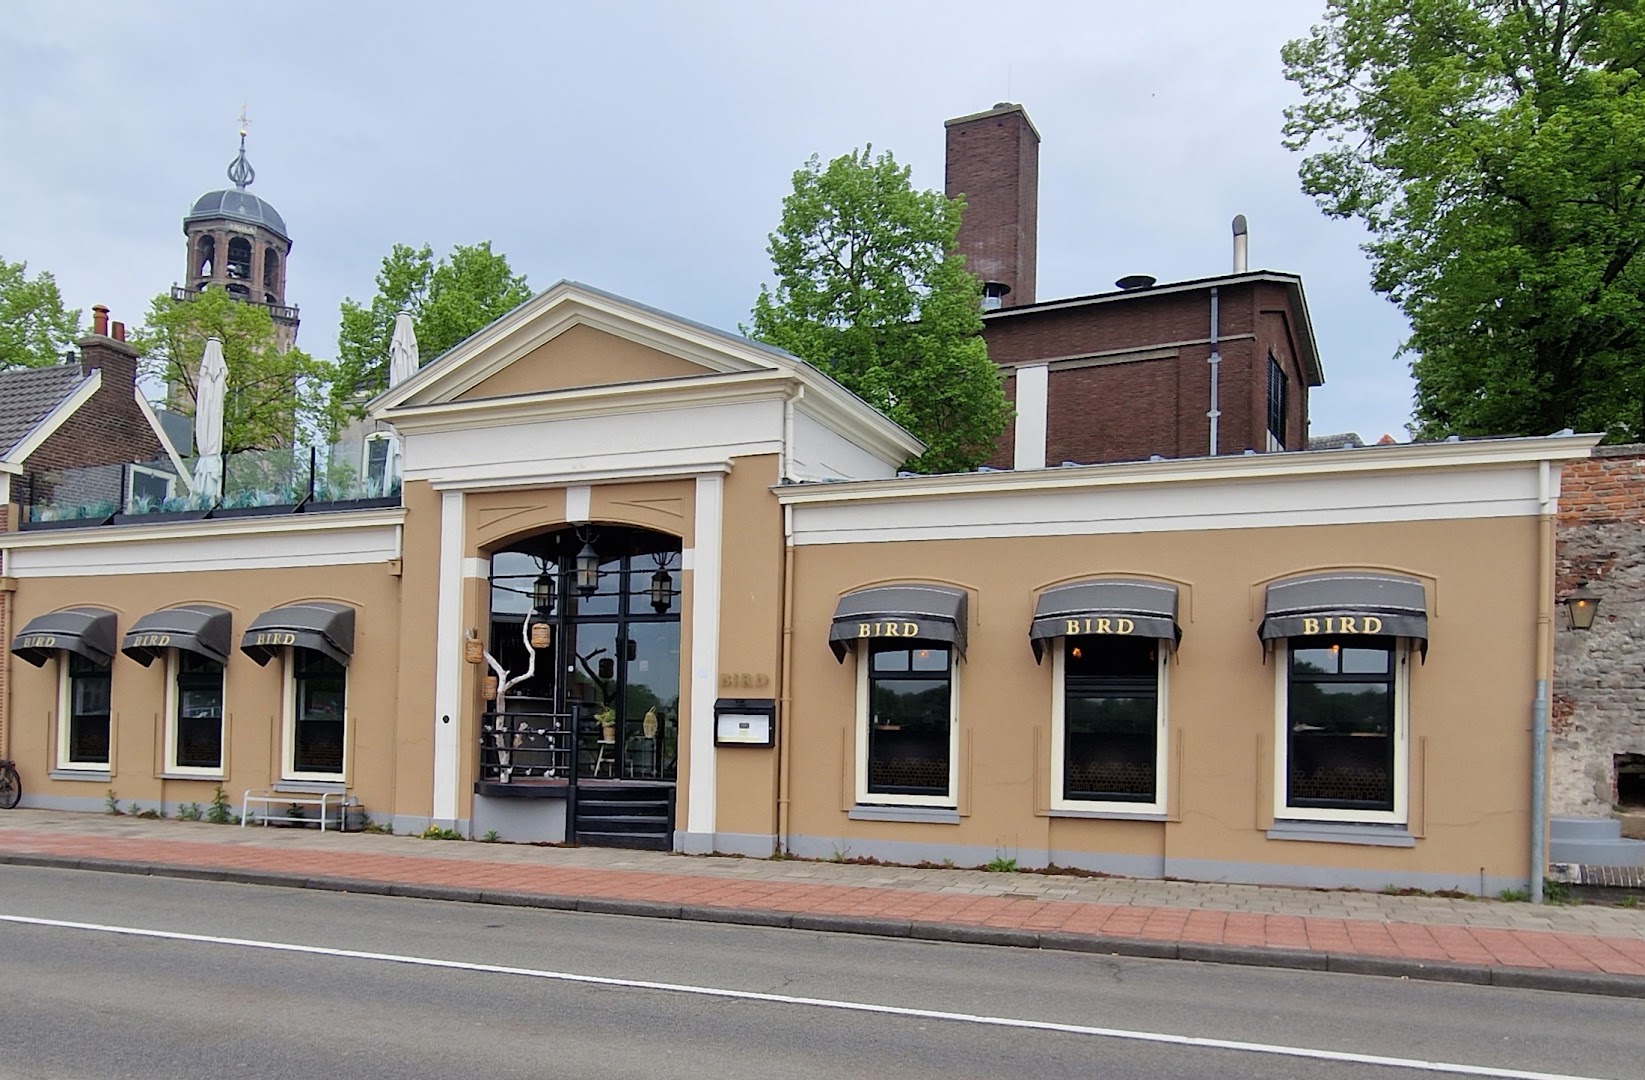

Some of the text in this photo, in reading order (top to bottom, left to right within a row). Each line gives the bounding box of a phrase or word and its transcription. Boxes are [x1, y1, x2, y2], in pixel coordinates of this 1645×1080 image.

[858, 622, 918, 637] BIRD
[1066, 618, 1134, 635] BIRD
[1303, 617, 1382, 635] BIRD
[24, 637, 56, 647] BIRD
[133, 635, 170, 647] BIRD
[256, 633, 295, 645] BIRD
[720, 673, 769, 688] BIRD
